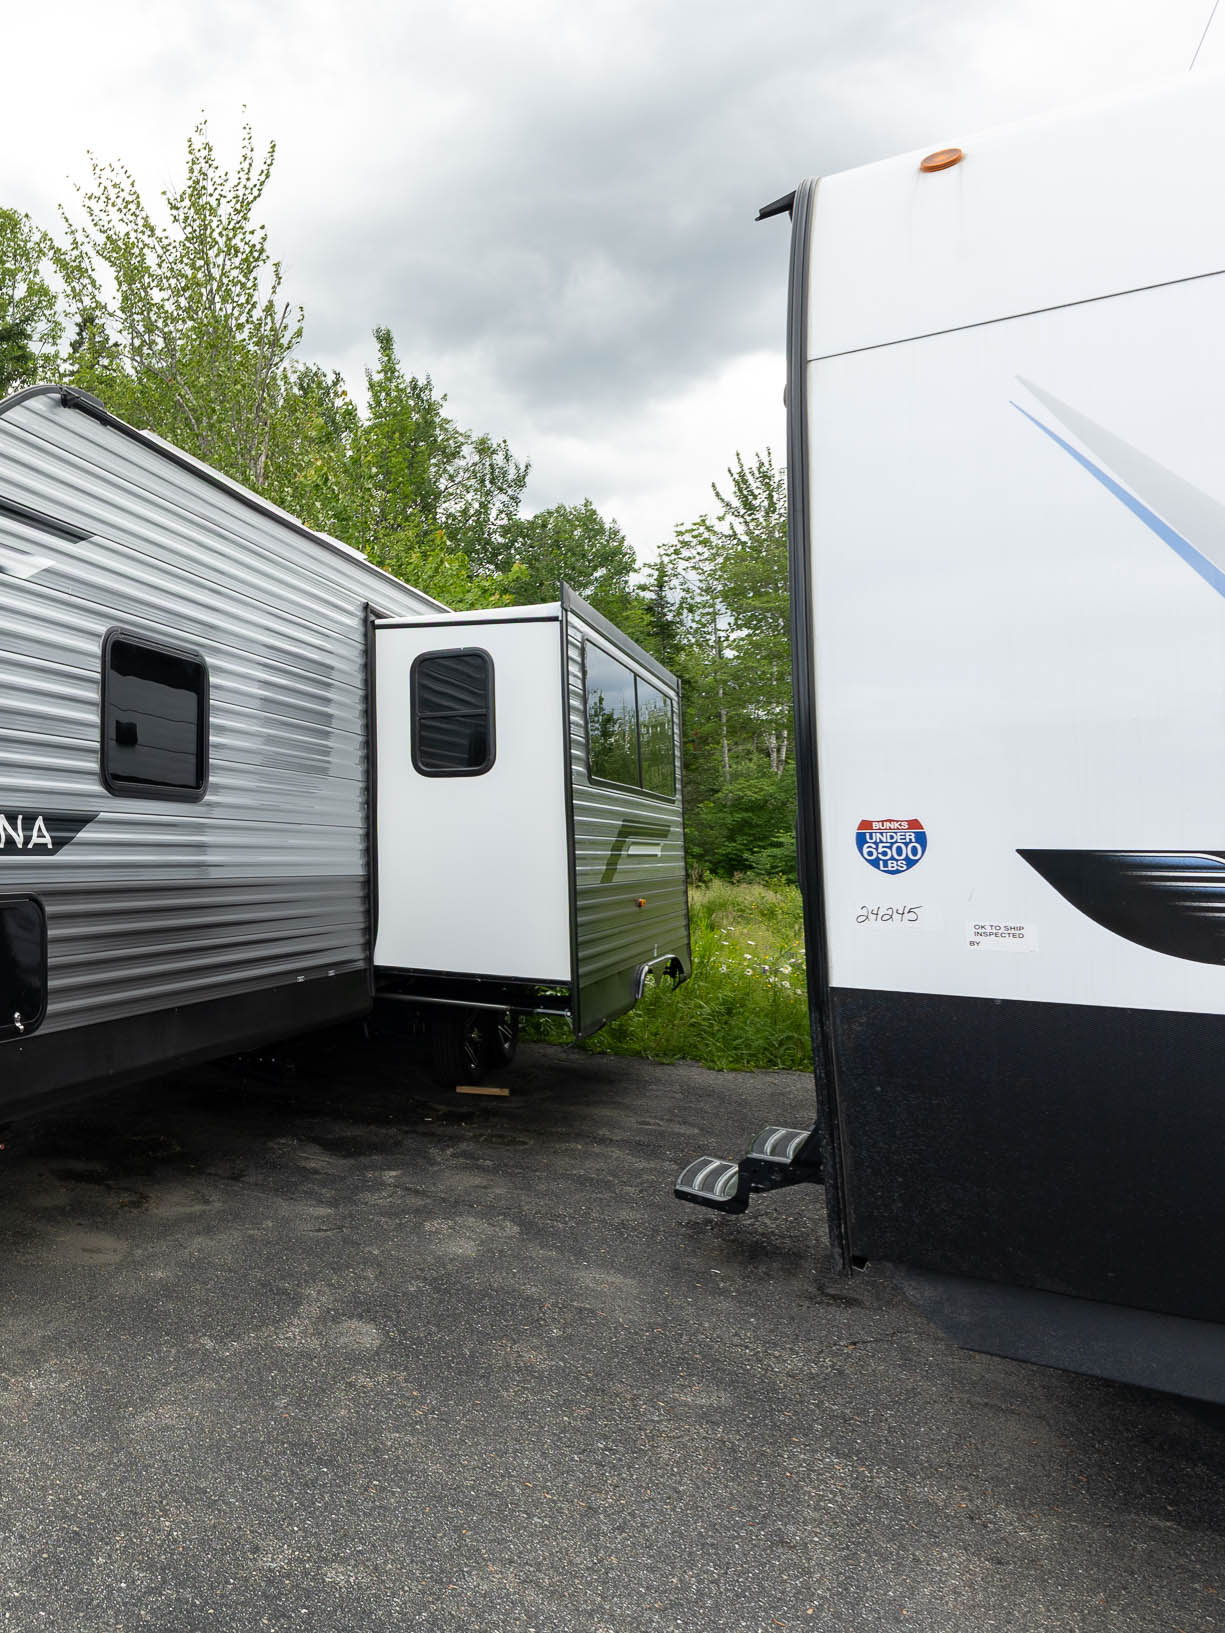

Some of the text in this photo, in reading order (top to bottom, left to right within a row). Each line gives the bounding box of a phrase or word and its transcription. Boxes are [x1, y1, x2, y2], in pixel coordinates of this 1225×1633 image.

[872, 821, 909, 830] BUNKS
[865, 832, 916, 843] UNDER
[862, 842, 922, 860] 6500
[879, 860, 907, 871] LBS
[855, 905, 923, 924] 24245
[973, 931, 1025, 939] INSPECTED
